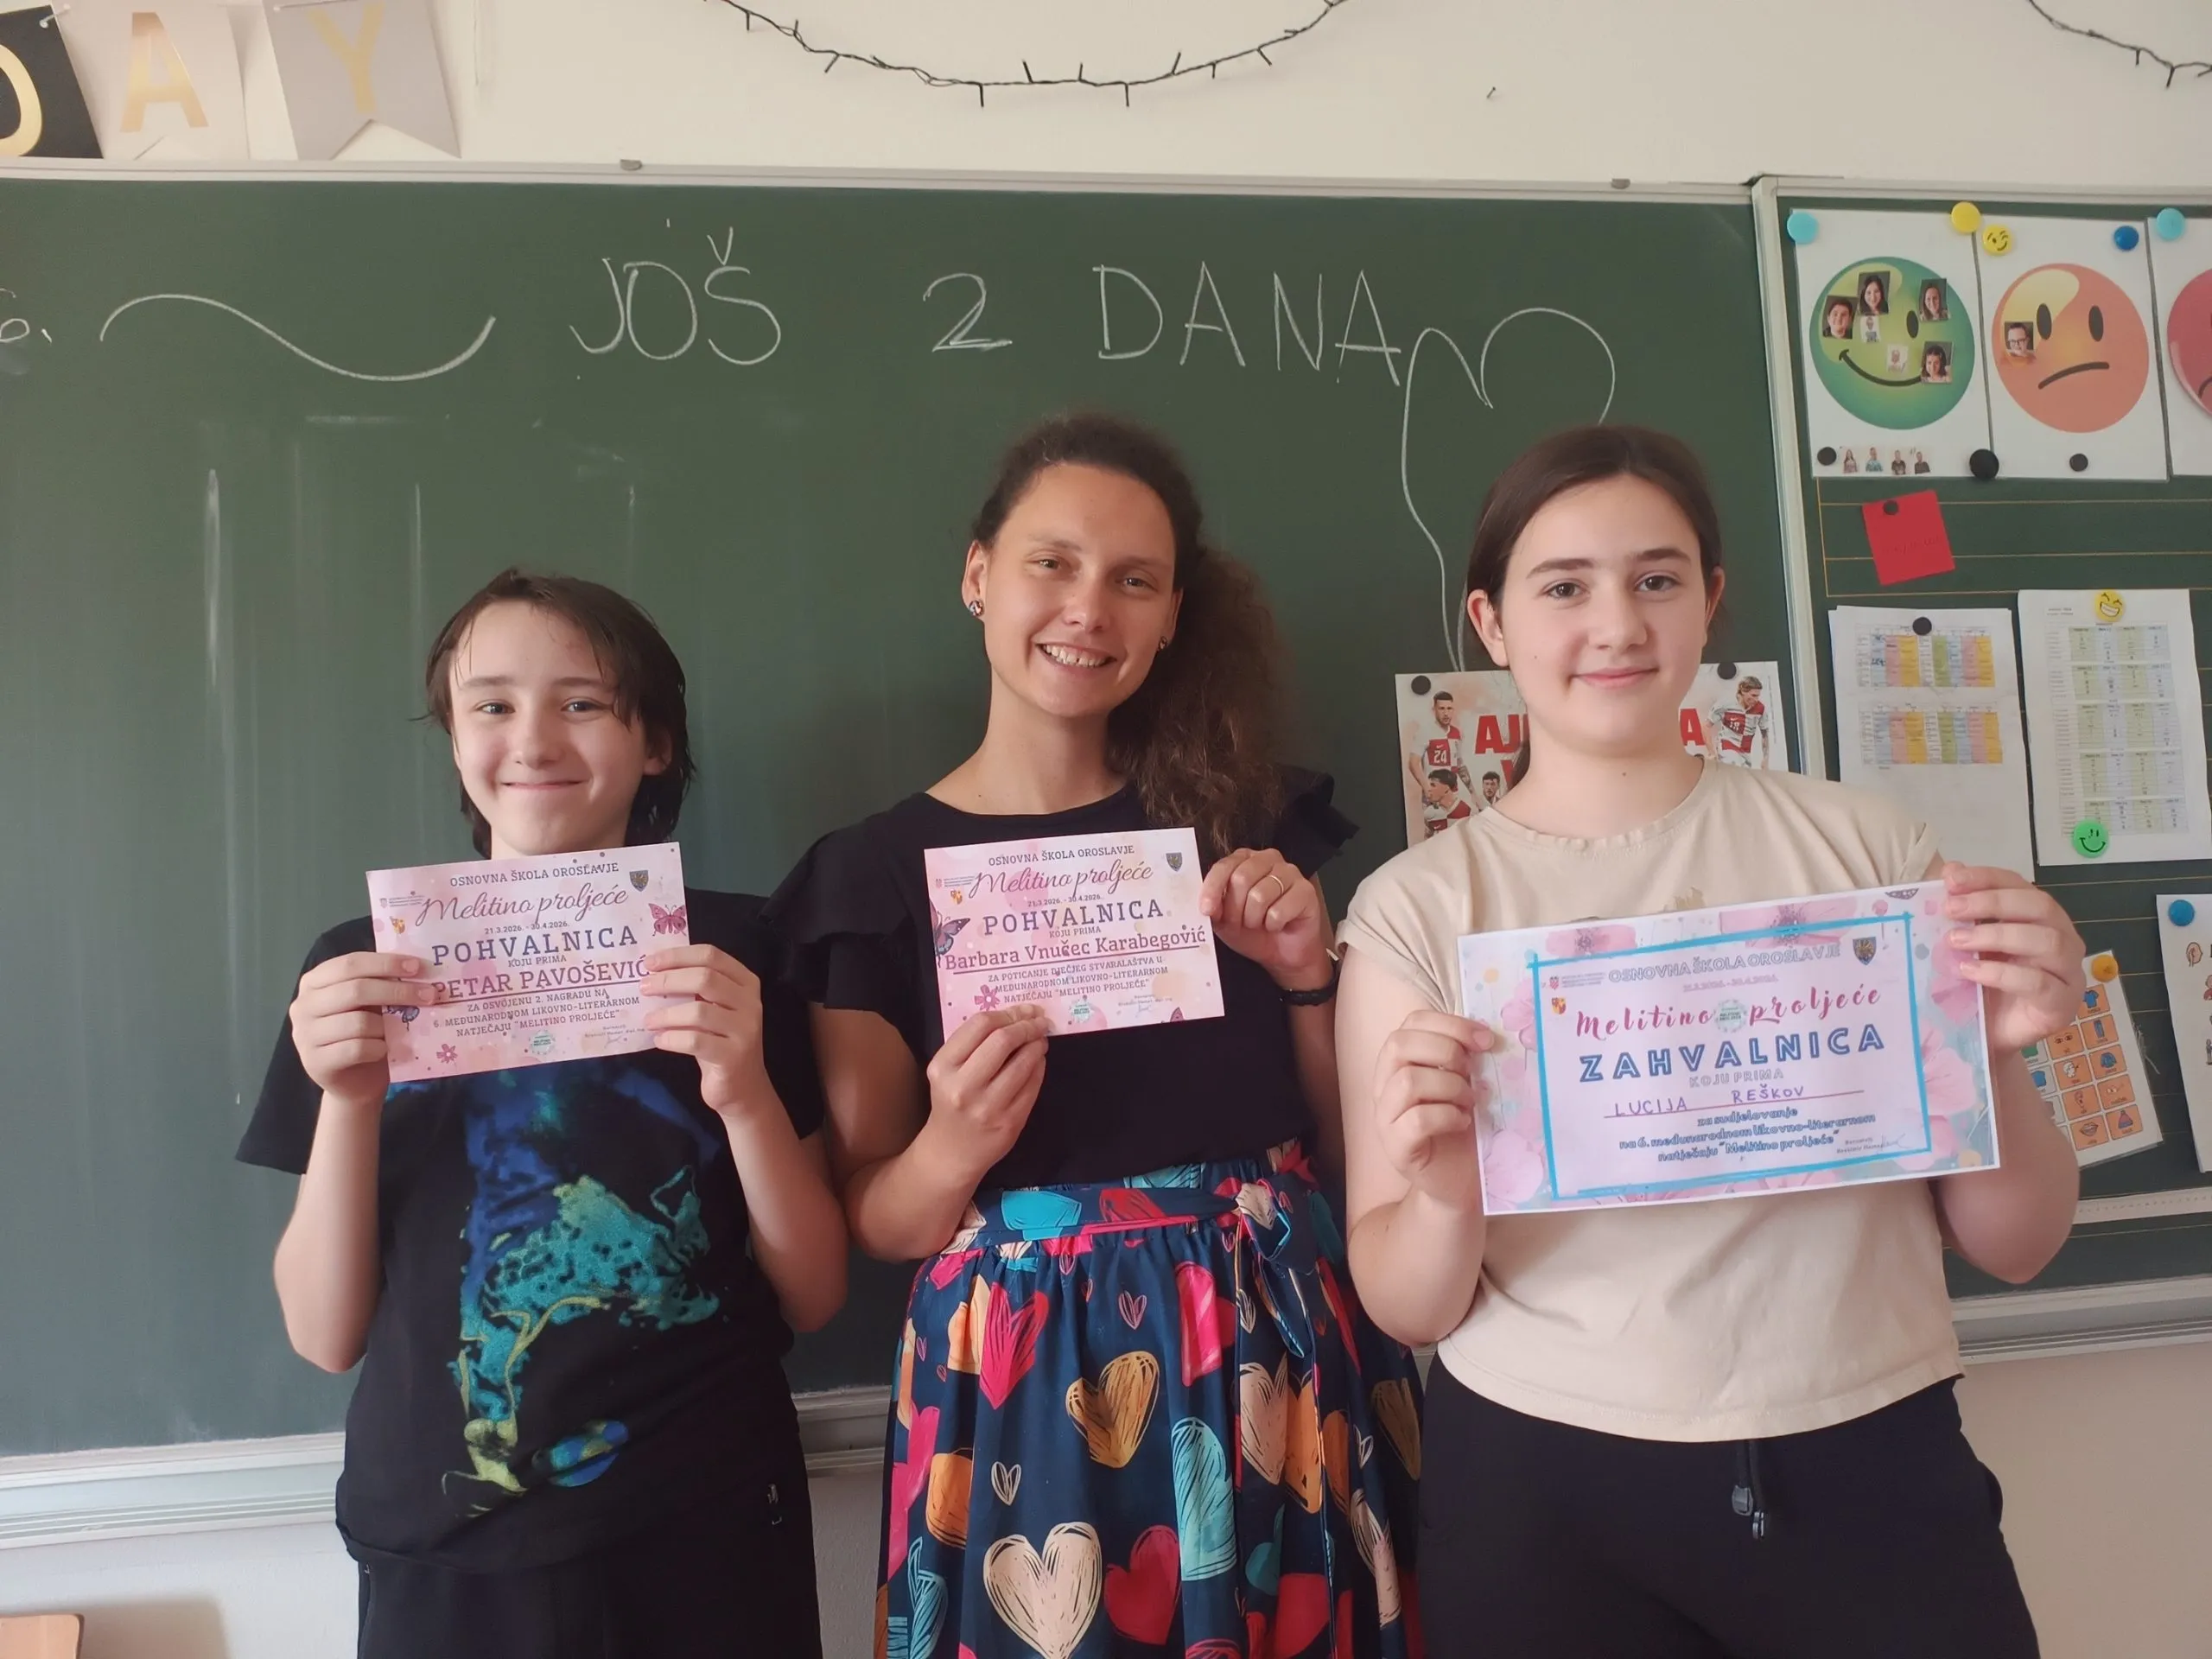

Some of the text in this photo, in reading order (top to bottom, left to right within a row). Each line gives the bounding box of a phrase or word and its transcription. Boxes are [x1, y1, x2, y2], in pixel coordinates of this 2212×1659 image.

[569, 226, 1401, 387] JOŠ 2 DANA
[1433, 749, 1447, 764] 24
[988, 845, 1135, 867] OSNOVNA ŠKOLA OROSLAVJE
[450, 862, 619, 887] OSNOVNA ŠKOLA OROSLAVJE
[969, 859, 1154, 899] Melitino proljeće
[415, 882, 629, 926] Melitino proljeće
[982, 899, 1164, 936] POHVALNICA
[1049, 925, 1102, 938] KOJU PRIMA
[432, 925, 638, 966] POHVALNICA
[944, 925, 1206, 970] Barbara Vnučec Karabegović
[508, 954, 567, 968] KOJU PRIMA
[519, 954, 650, 989] PAVOŠEVIĆ
[1002, 969, 1048, 981] POTICANJE
[1051, 963, 1087, 976] DJEČJEG
[1089, 957, 1154, 971] STVARALAŠTVA
[1608, 962, 1691, 983] OSNOVNA
[1692, 955, 1746, 974] ŠKOLA
[1747, 944, 1841, 967] OROSLAVJE
[1071, 966, 1168, 984] LIKOVNO-LITERARNOM
[467, 1003, 480, 1013] ZA
[482, 996, 532, 1010] OSVOJENU
[546, 990, 592, 1002] NAGRADU
[594, 988, 608, 997] NA
[532, 996, 640, 1015] LIKOVNO-LITERARNOM
[1004, 989, 1052, 1003] NATJEČAJU
[1576, 983, 1880, 1041] Melitino proljeće
[456, 1022, 512, 1037] NATJEČAJU
[1580, 1023, 1885, 1083] ZAHVALNICA
[1689, 1067, 1784, 1088] KOJU PRIMA
[1615, 1084, 1804, 1116] LUCIJA REŠKOV
[1697, 1106, 1798, 1127] za sudjelovanje
[1619, 1140, 1636, 1149] na
[1637, 1136, 1649, 1148] 6.
[1752, 1113, 1876, 1136] likovno-literarnom
[1658, 1147, 1718, 1161] natječaju
